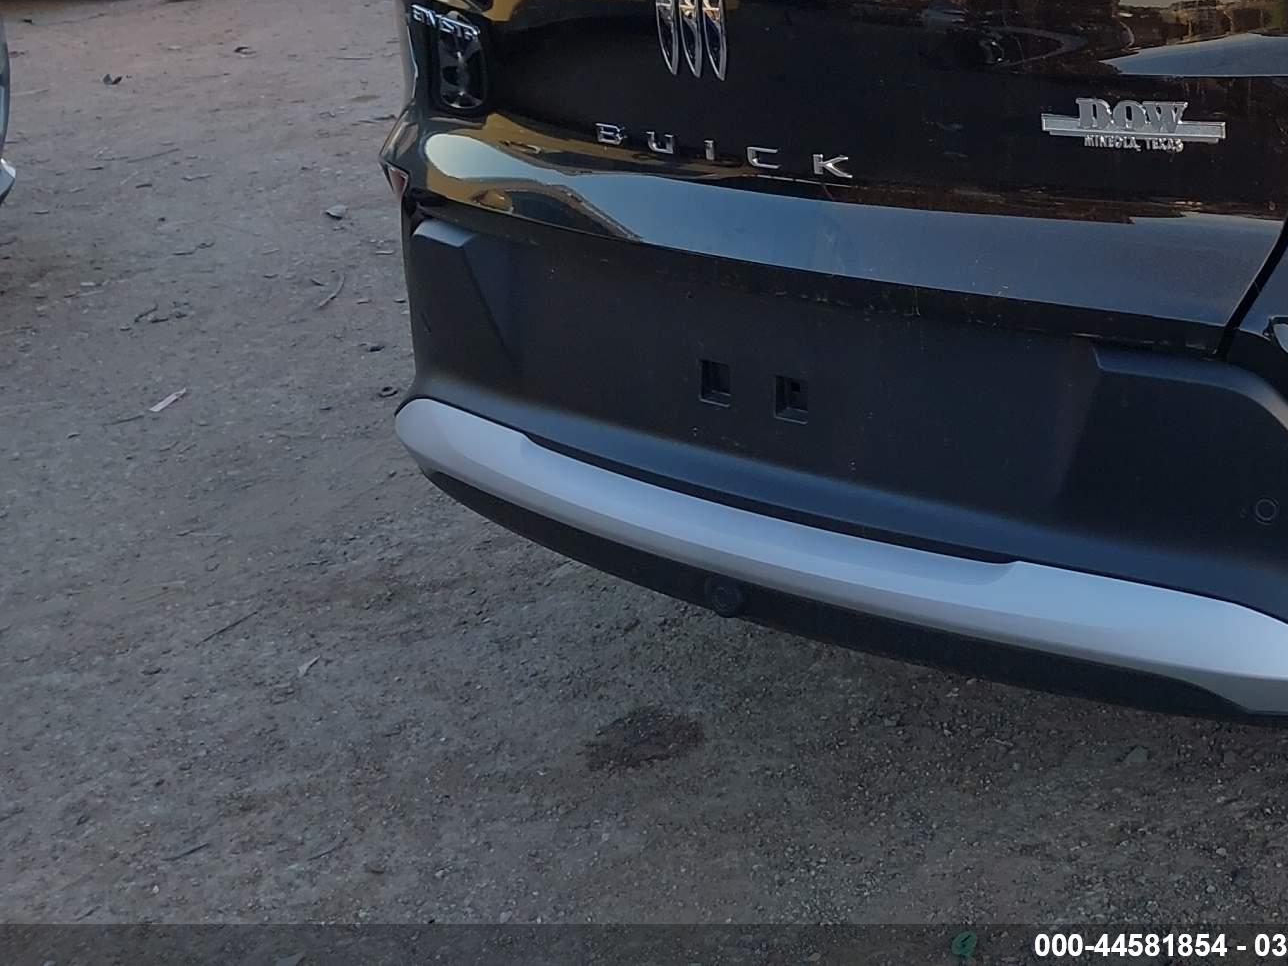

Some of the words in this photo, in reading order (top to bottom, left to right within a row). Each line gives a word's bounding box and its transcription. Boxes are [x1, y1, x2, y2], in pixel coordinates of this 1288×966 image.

[1075, 97, 1188, 134] DOW
[595, 122, 853, 179] BUICK
[1145, 137, 1184, 153] TEXAS
